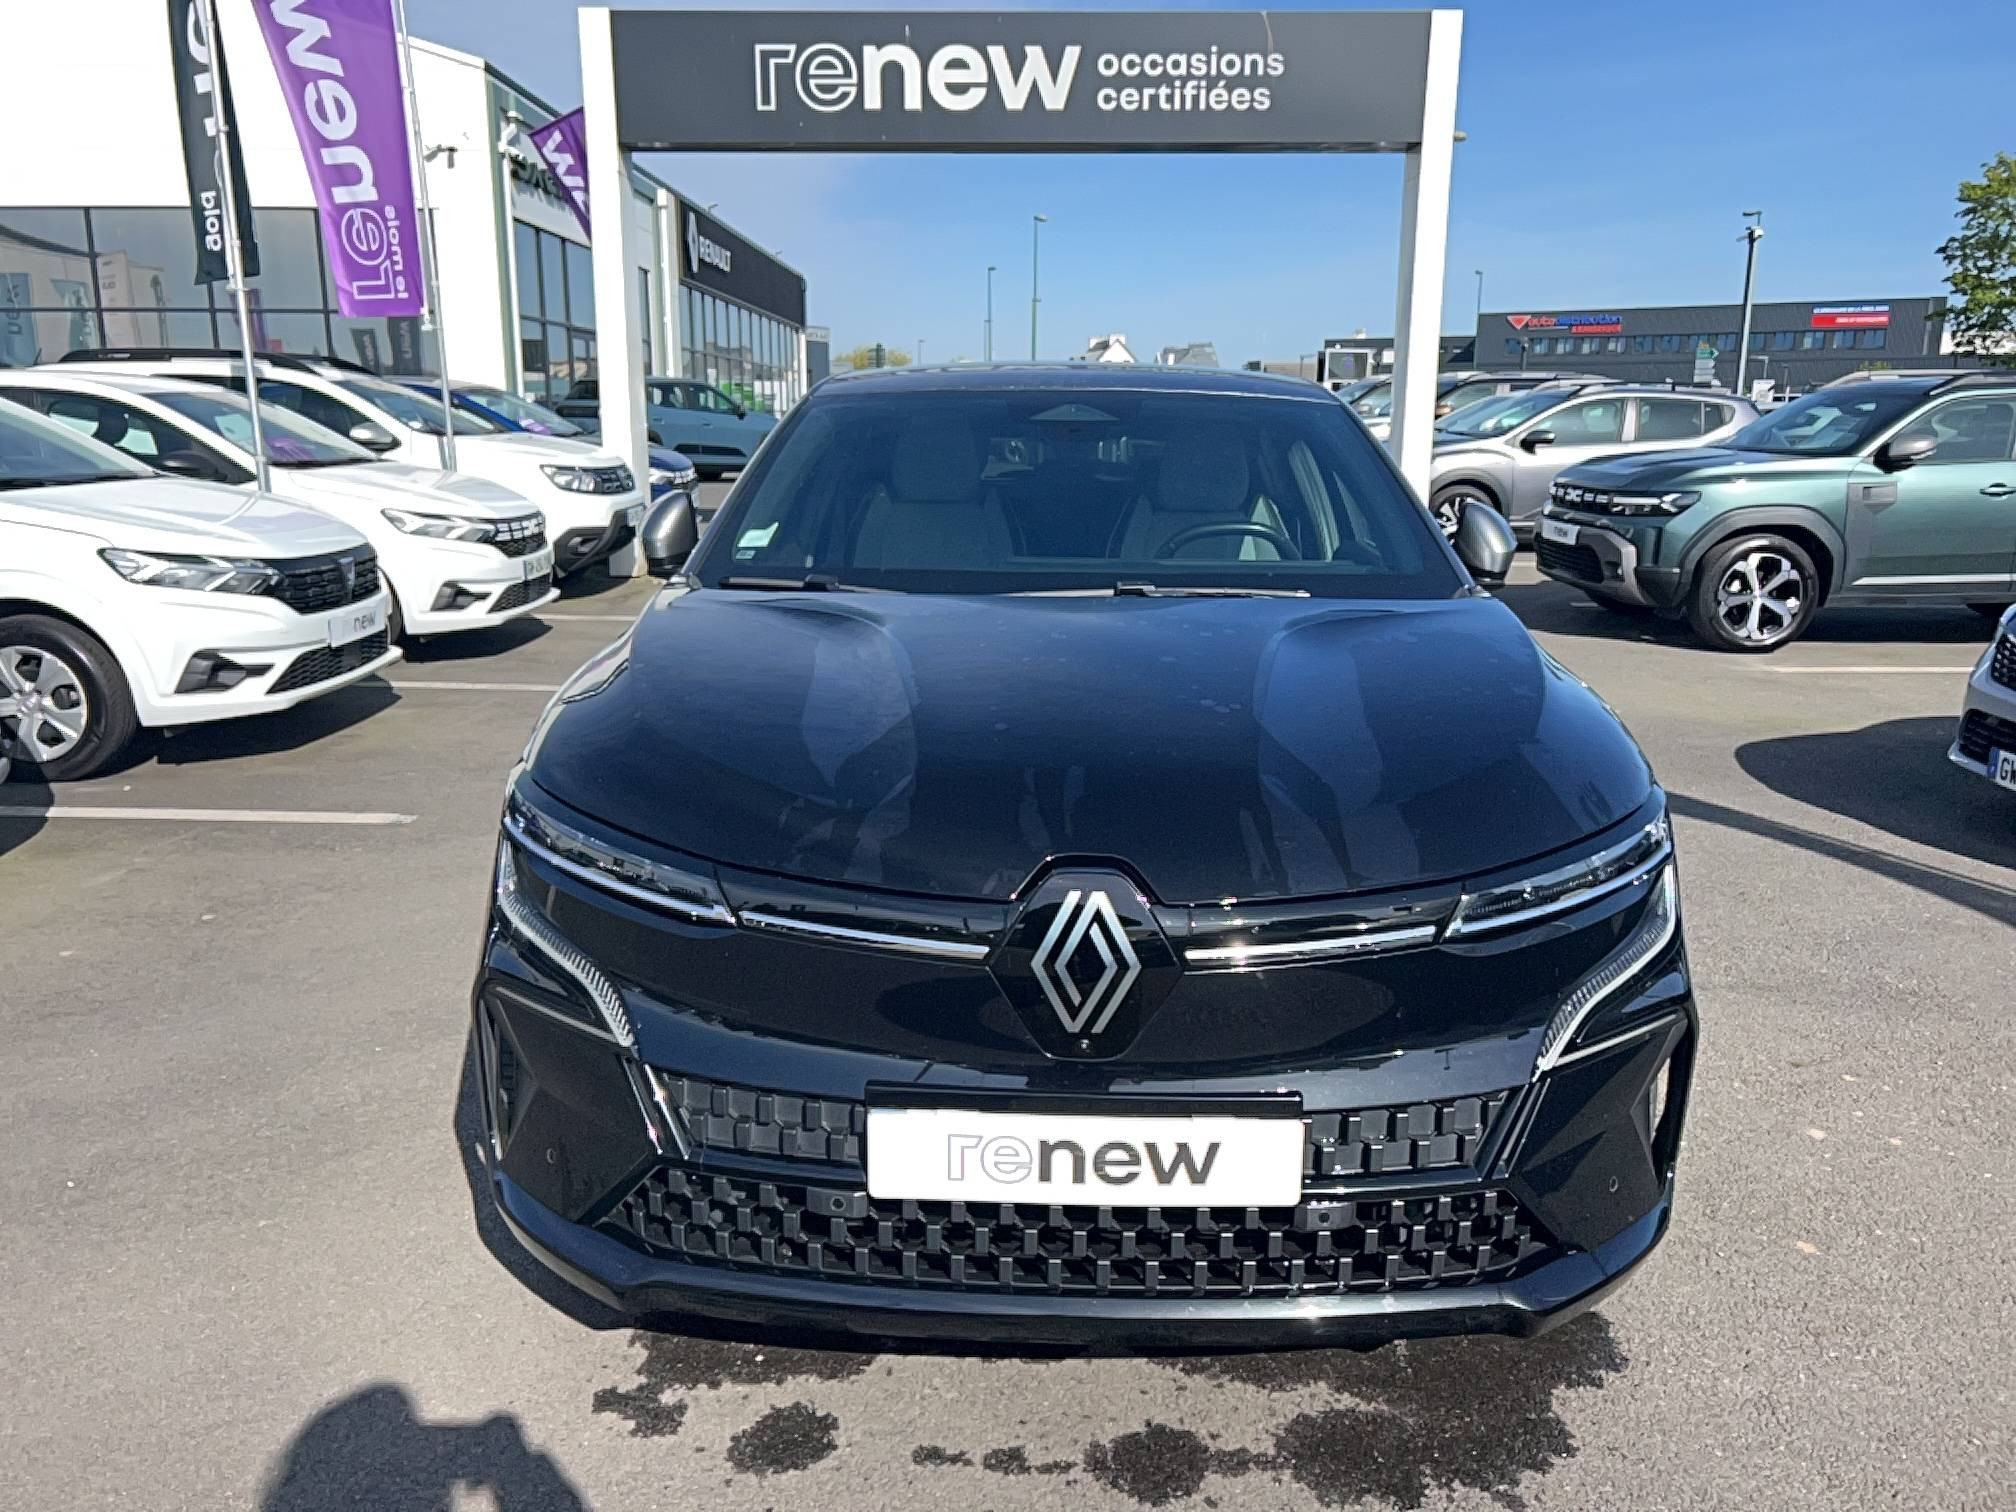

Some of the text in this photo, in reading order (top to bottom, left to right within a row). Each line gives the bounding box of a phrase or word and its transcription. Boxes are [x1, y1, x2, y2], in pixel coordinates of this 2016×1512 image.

[753, 43, 1082, 112] renew
[1098, 47, 1285, 78] occasions
[1098, 78, 1272, 112] certifiées
[947, 1133, 1222, 1186] renew
